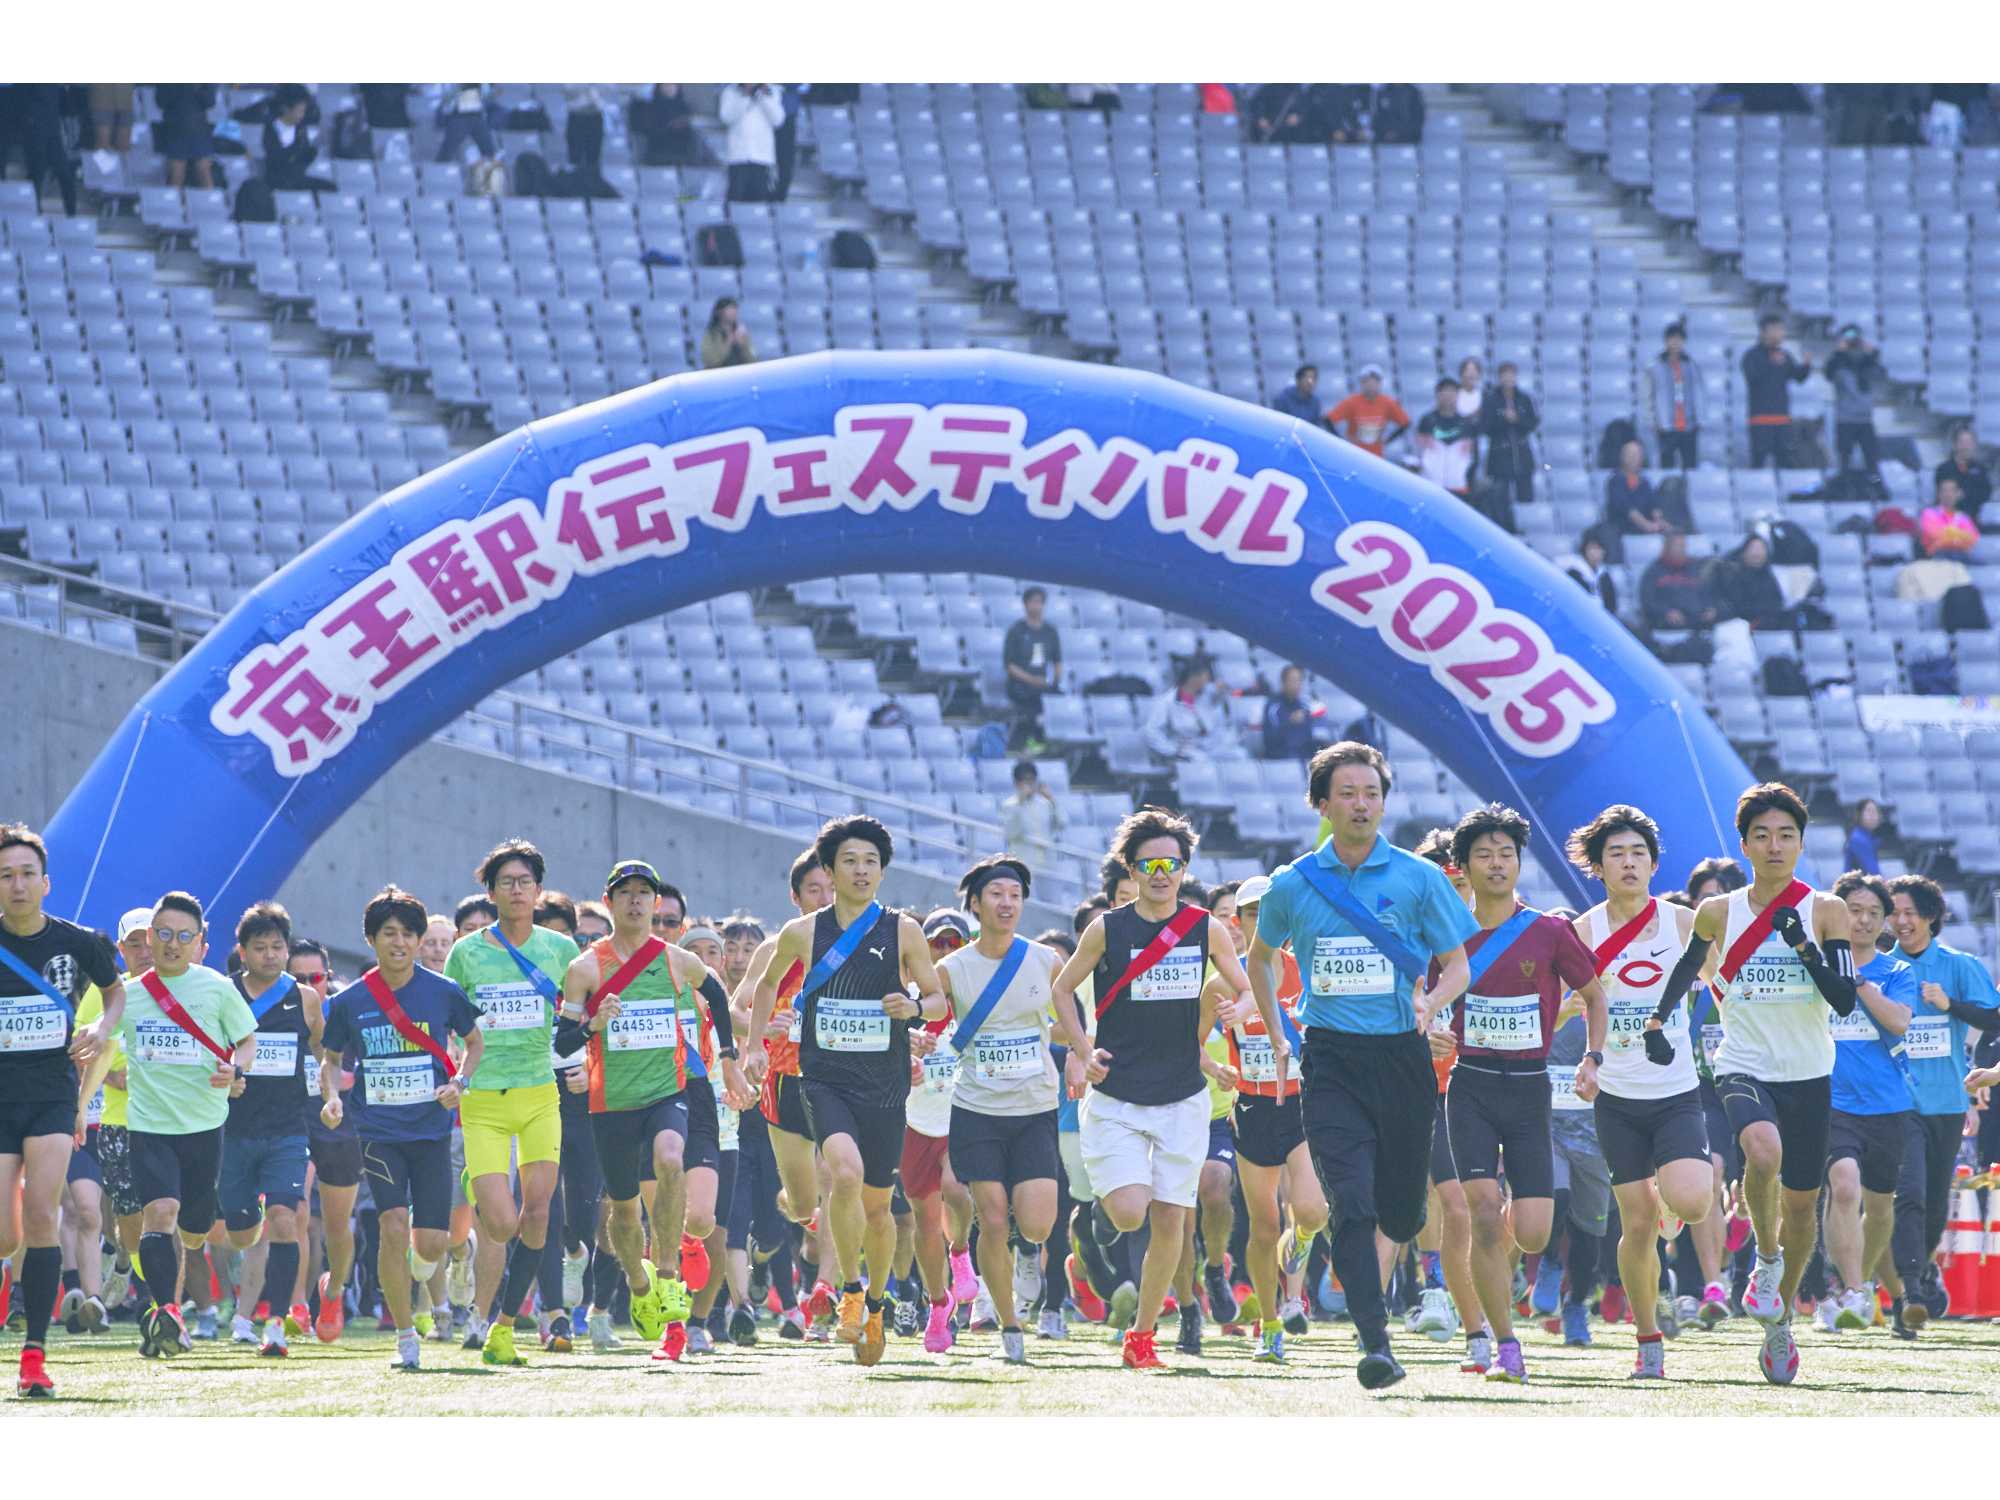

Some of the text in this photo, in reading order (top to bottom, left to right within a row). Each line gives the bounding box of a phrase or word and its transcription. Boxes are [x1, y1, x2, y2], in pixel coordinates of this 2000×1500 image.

[226, 414, 1598, 766] 京王駅伝フェスティバル 2025
[1313, 958, 1387, 974] E4208-1
[1736, 967, 1807, 983] A5002-1
[480, 999, 539, 1015] C4132-1
[610, 1017, 671, 1033] G4453-1
[820, 1016, 885, 1034] B4054-1
[1468, 1014, 1535, 1031] A4018-1
[1905, 1032, 1946, 1044] 239-1
[979, 1045, 1037, 1063] B4071-1
[369, 1074, 429, 1089] J4575-1
